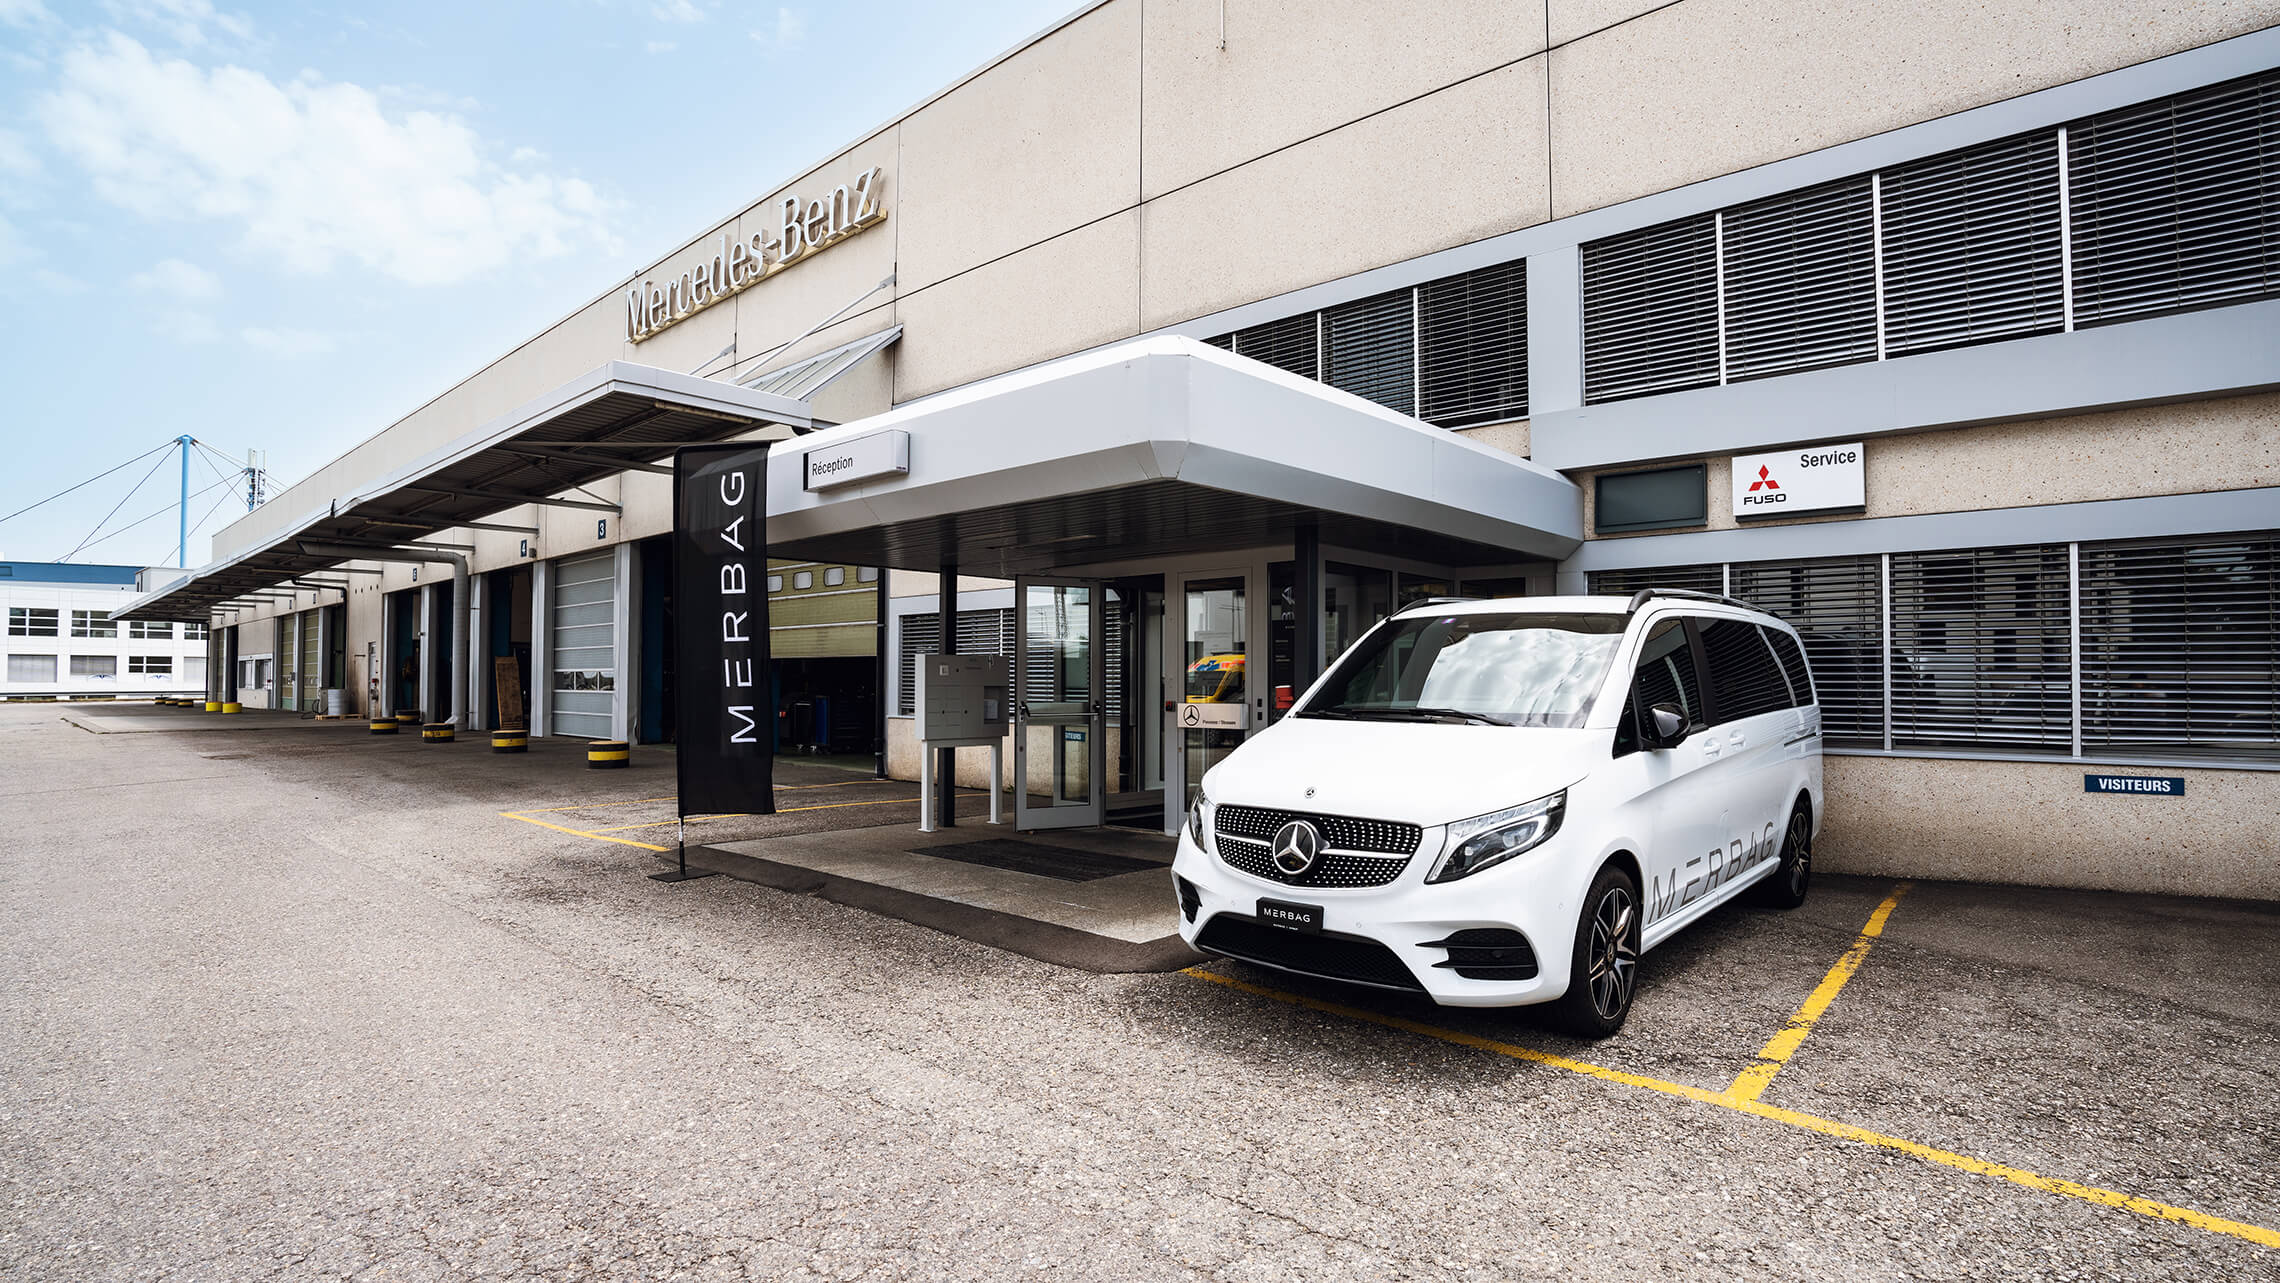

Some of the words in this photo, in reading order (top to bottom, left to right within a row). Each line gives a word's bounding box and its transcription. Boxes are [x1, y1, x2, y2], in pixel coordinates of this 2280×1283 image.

[624, 166, 884, 343] Mercedes-Benz
[811, 456, 854, 477] Réception
[1800, 450, 1857, 469] Service
[1743, 493, 1787, 506] FUSO
[599, 522, 605, 537] 3
[720, 470, 758, 744] MERBAG
[2098, 777, 2172, 793] VISITEURS
[1647, 821, 1775, 925] MERBAG
[1263, 907, 1312, 923] MERBAG
